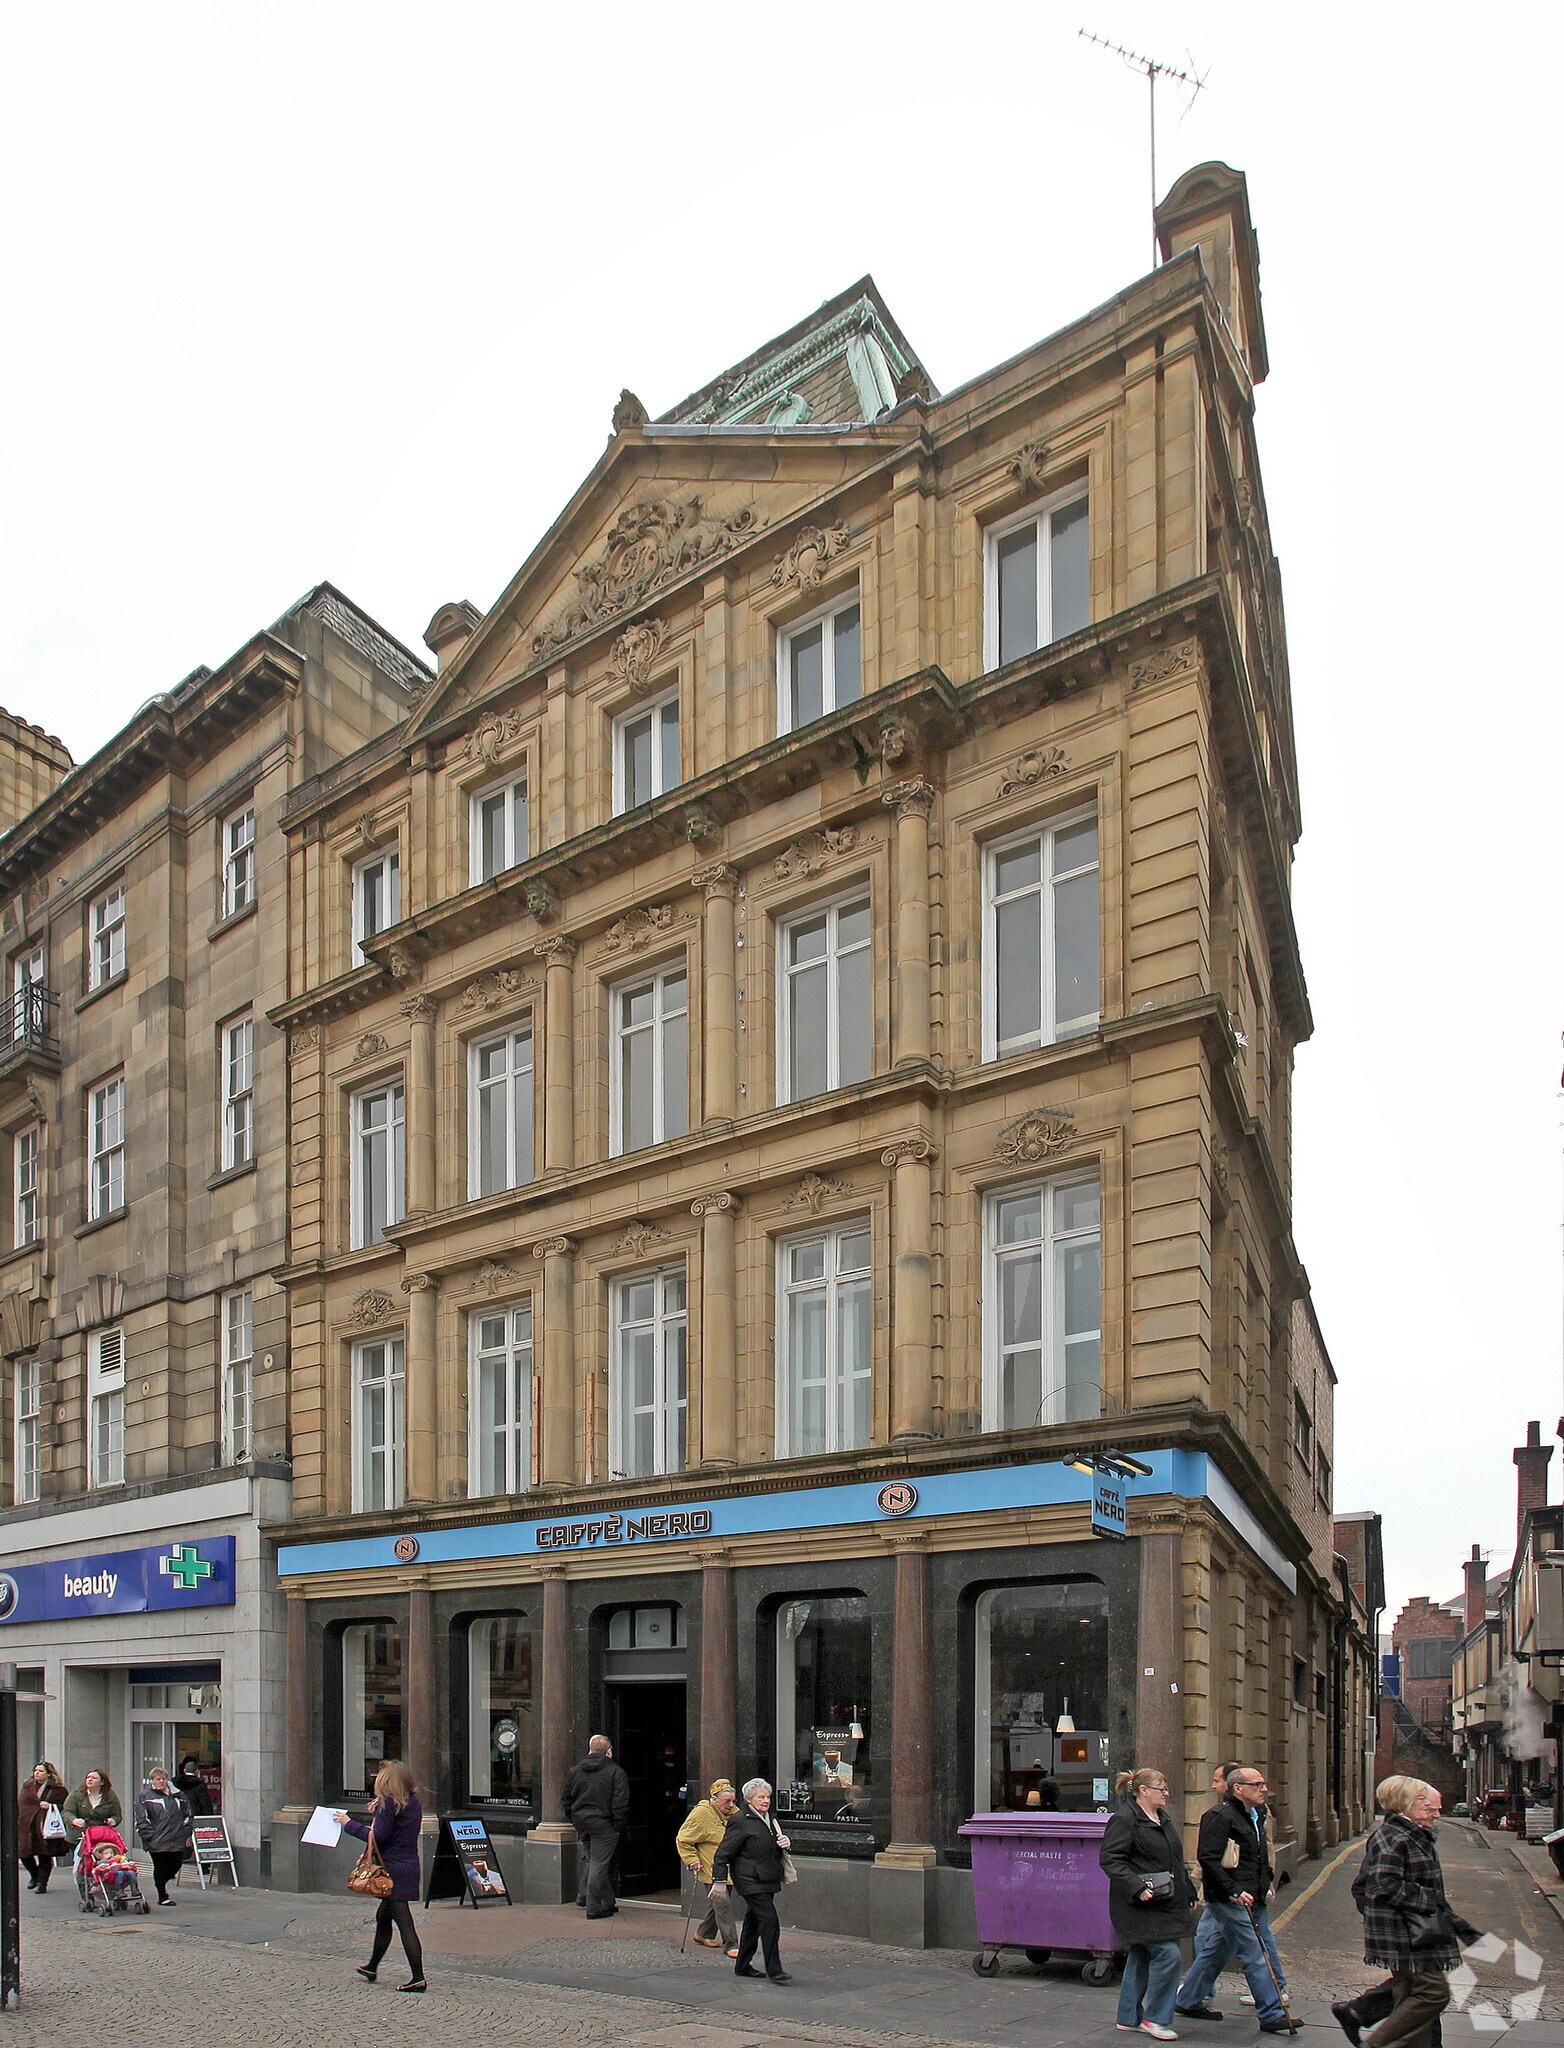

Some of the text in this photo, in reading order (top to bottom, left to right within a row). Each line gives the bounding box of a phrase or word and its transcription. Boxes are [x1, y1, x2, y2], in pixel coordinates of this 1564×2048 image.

[889, 1490, 905, 1506] N
[1099, 1487, 1120, 1503] CAFFÈ
[1094, 1497, 1125, 1522] NERO
[535, 1509, 712, 1548] CAFFÈ NERO
[64, 1569, 118, 1599] beauty
[816, 1731, 849, 1740] Espresso
[203, 1775, 209, 1783] 3
[460, 1842, 488, 1851] Espresso
[1040, 1851, 1062, 1859] WASTE
